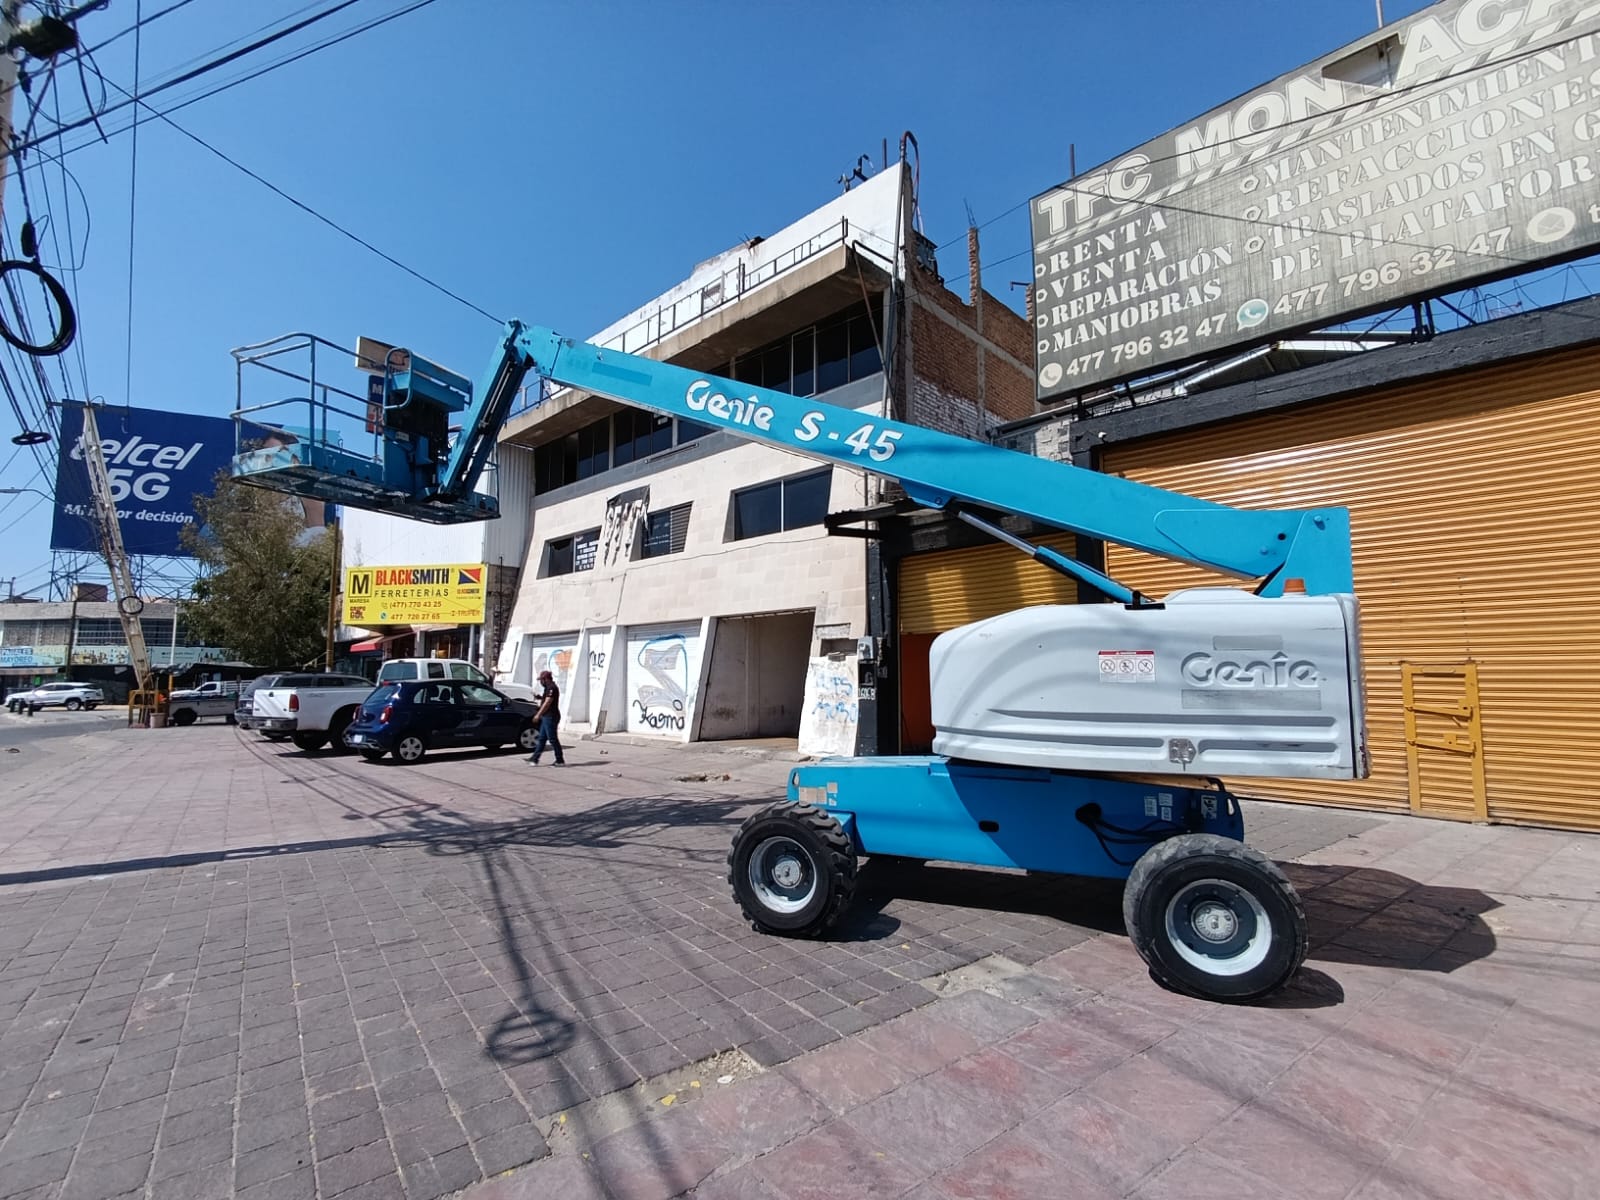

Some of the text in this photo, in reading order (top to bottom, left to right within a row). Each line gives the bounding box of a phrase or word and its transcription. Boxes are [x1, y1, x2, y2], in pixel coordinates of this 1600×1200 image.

[1038, 154, 1151, 236] TFC
[1268, 151, 1485, 249] TRASLADOS
[1499, 125, 1556, 169] EN
[1050, 211, 1167, 275] RENTA
[1051, 241, 1166, 298] VENTA
[1271, 245, 1322, 281] DE
[1273, 226, 1512, 315] 477 796 32 47
[1052, 243, 1233, 326] REPARACIÓN
[1053, 278, 1222, 353] MANIOBRAS
[1066, 313, 1227, 376] 477 796 32 47
[686, 379, 776, 432] Genie
[107, 467, 171, 502] 5G
[135, 509, 194, 524] decisión
[352, 568, 450, 594] M BLACKSMITH
[1181, 650, 1320, 688] Genie
